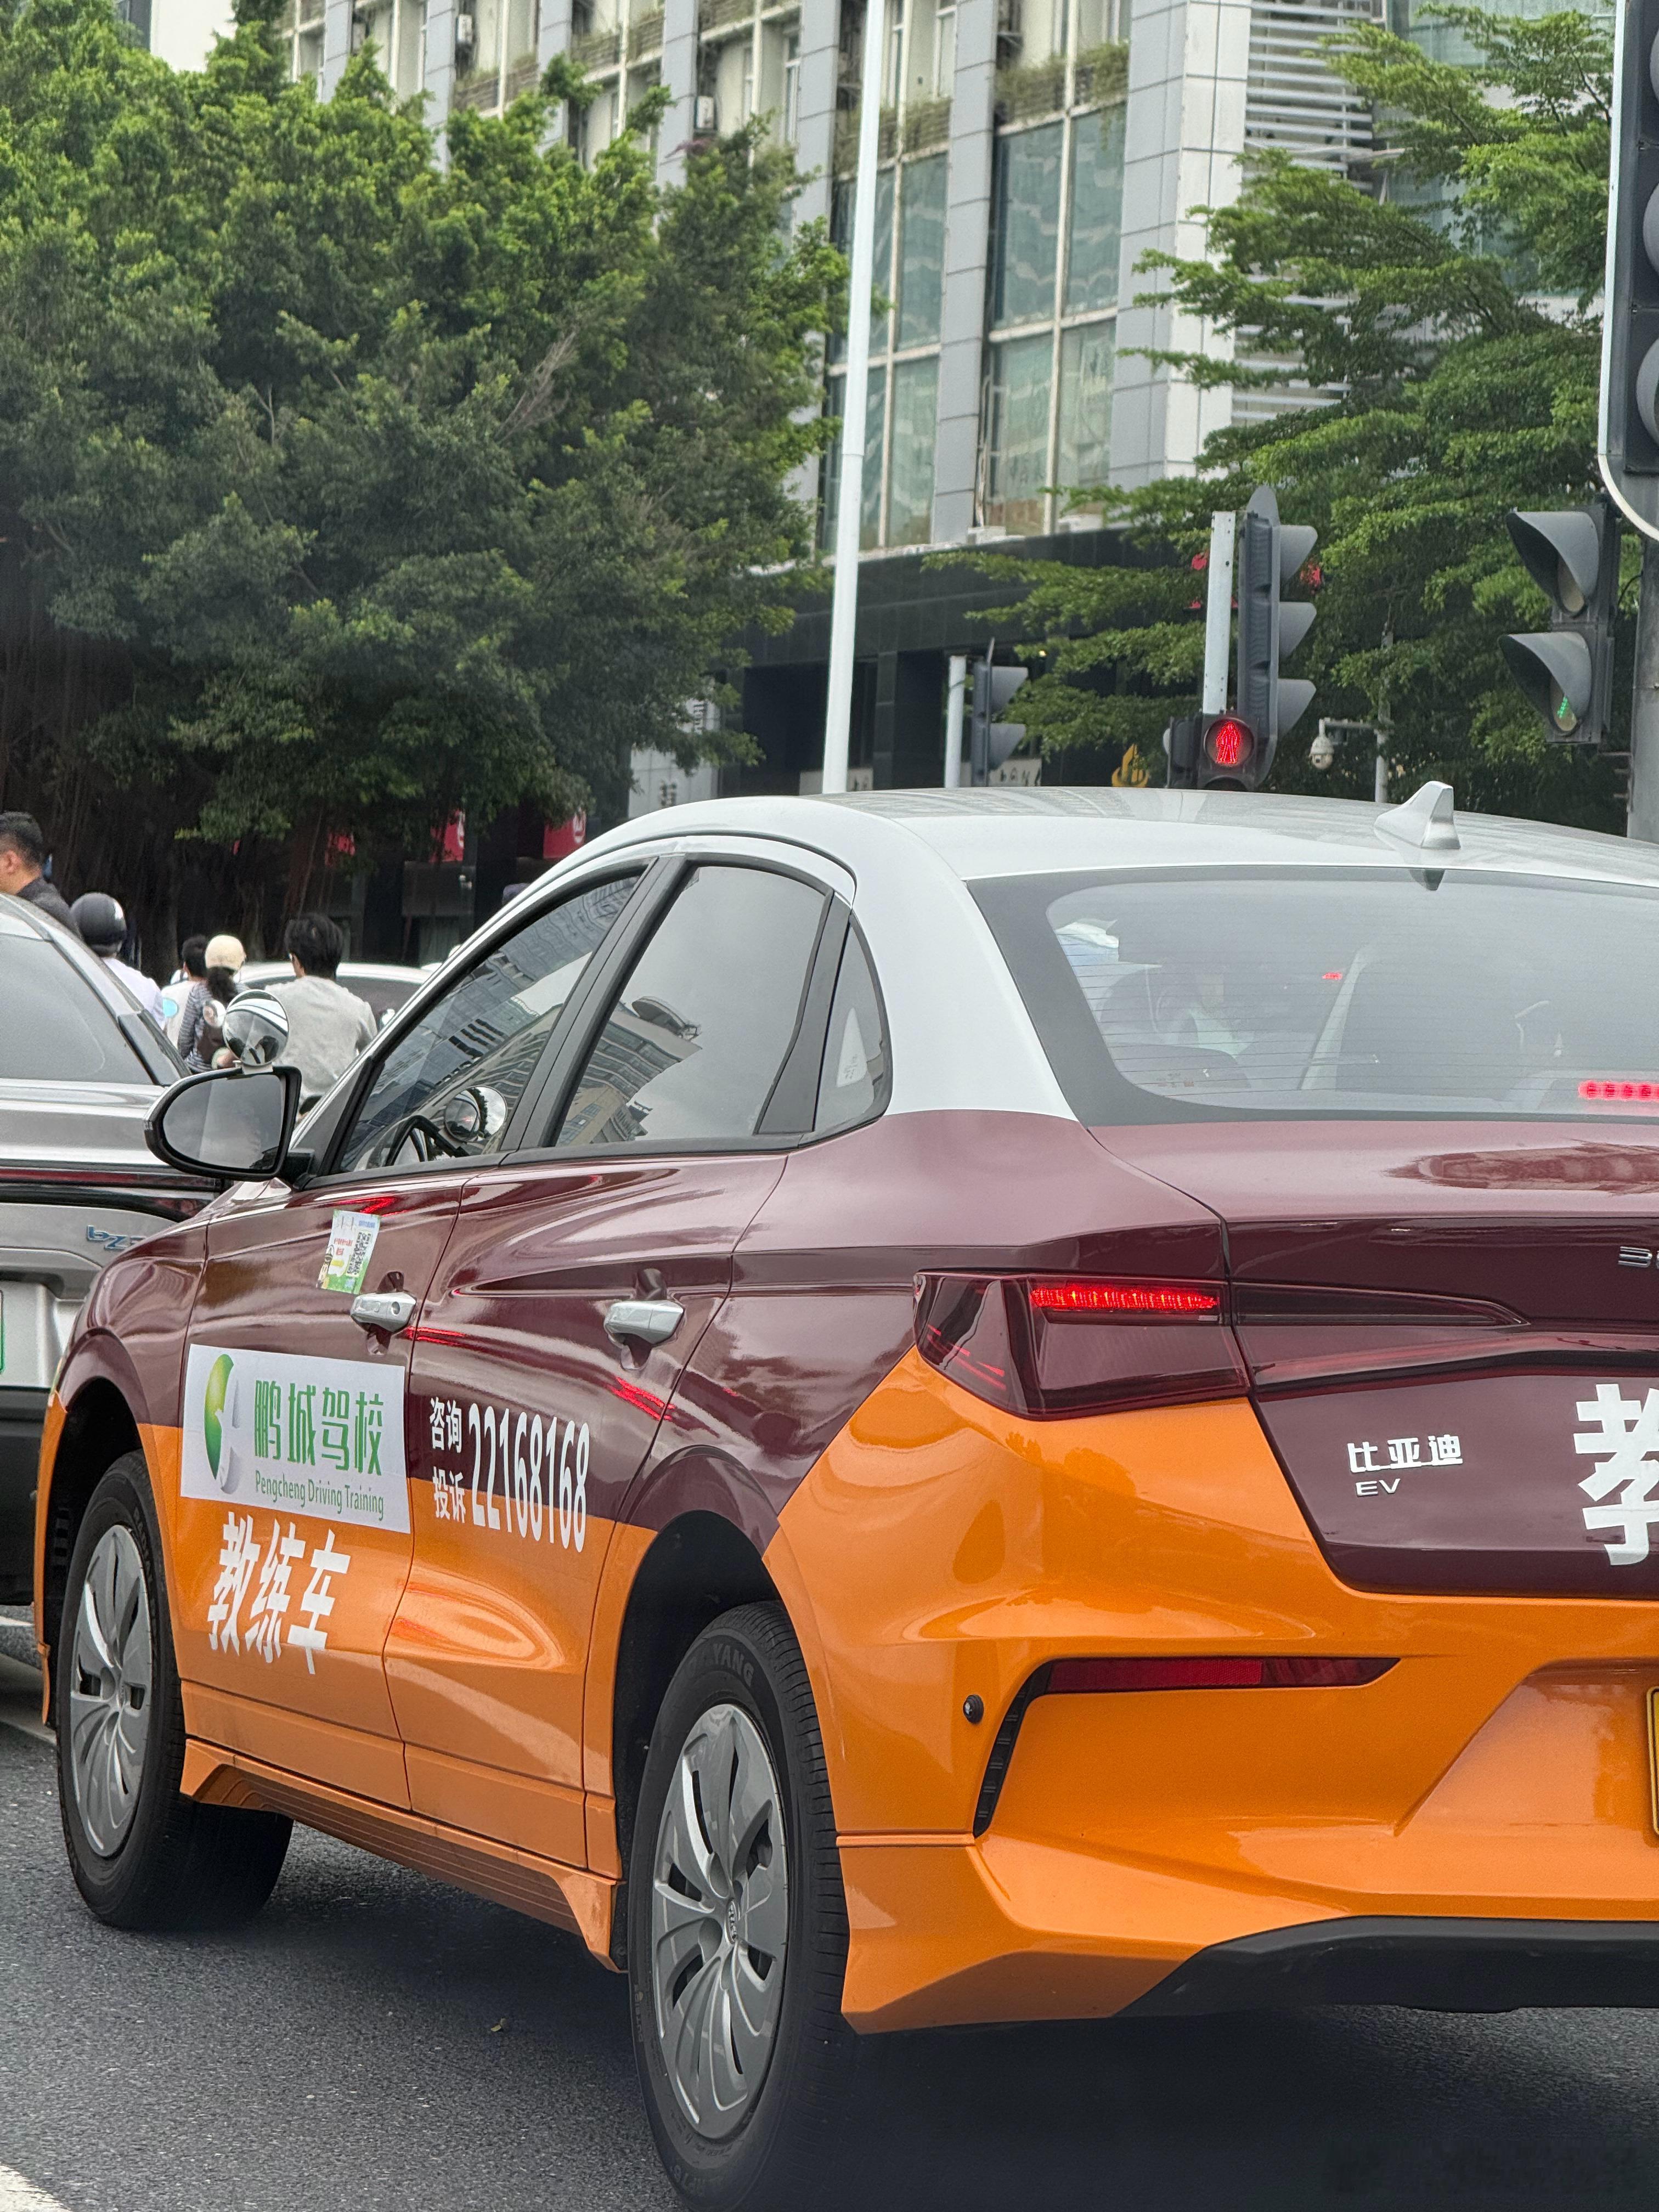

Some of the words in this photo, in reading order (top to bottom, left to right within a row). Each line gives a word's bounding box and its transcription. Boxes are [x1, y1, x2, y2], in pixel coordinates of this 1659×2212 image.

[255, 1380, 383, 1476] 鹏城驾校
[430, 1397, 462, 1453] 咨询
[1347, 1434, 1463, 1472] 比亚迪
[255, 1470, 306, 1508] Pengcheng
[308, 1479, 343, 1514] Driving
[344, 1484, 384, 1522] Training
[432, 1466, 466, 1523] 投诉
[469, 1403, 589, 1553] 22168168
[1356, 1478, 1401, 1496] EV
[207, 1511, 351, 1675] 教练车
